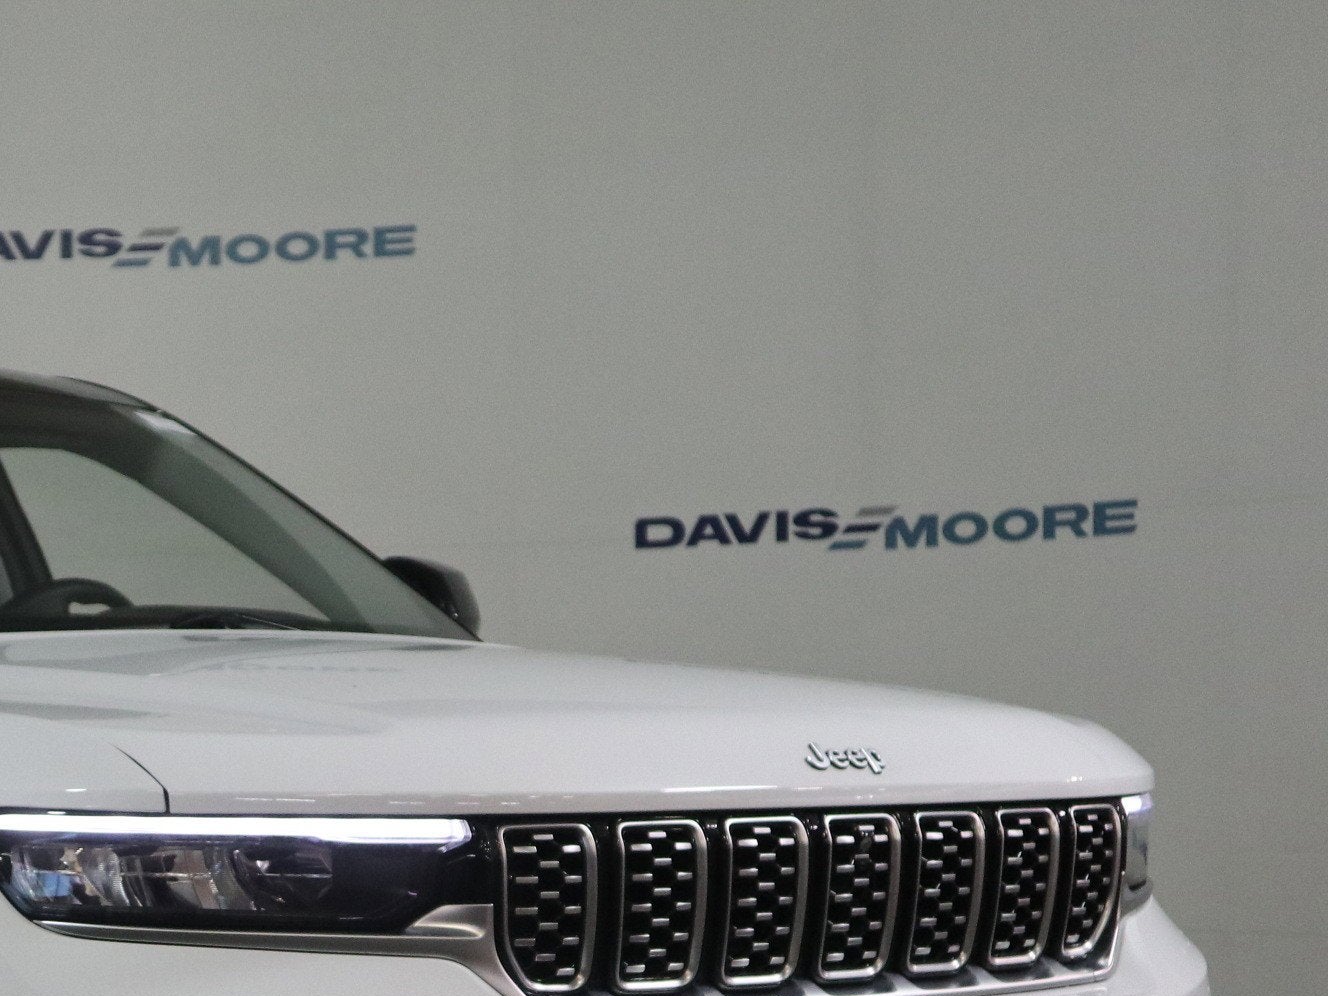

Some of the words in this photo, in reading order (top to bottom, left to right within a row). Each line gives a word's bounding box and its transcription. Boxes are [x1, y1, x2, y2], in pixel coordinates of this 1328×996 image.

[169, 224, 417, 268] MOORE
[634, 507, 840, 550] DAVIS
[883, 499, 1139, 551] MOORE
[805, 741, 886, 775] Jeep
